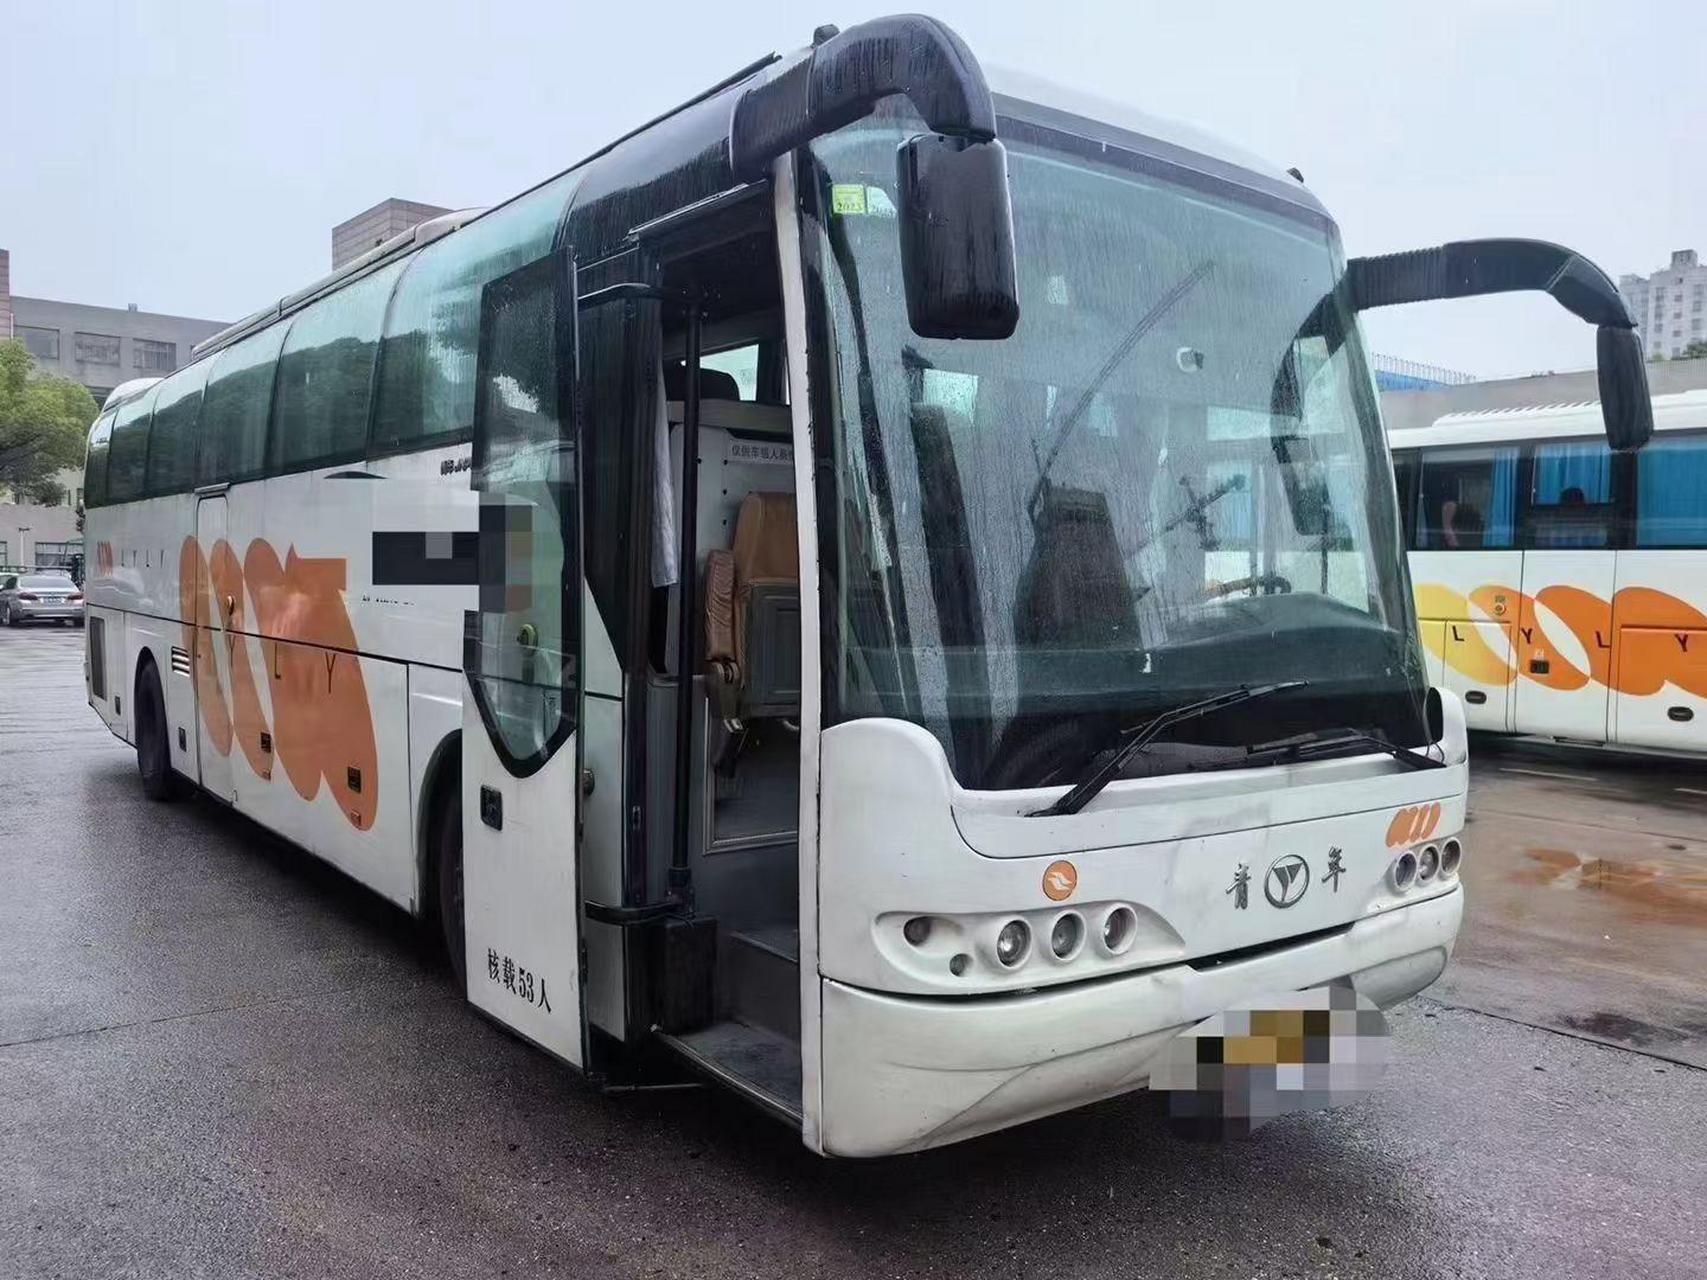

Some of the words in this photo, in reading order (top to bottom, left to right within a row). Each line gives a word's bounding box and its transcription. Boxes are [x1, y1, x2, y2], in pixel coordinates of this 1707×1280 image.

[732, 445, 793, 460] 仅供车组人员
